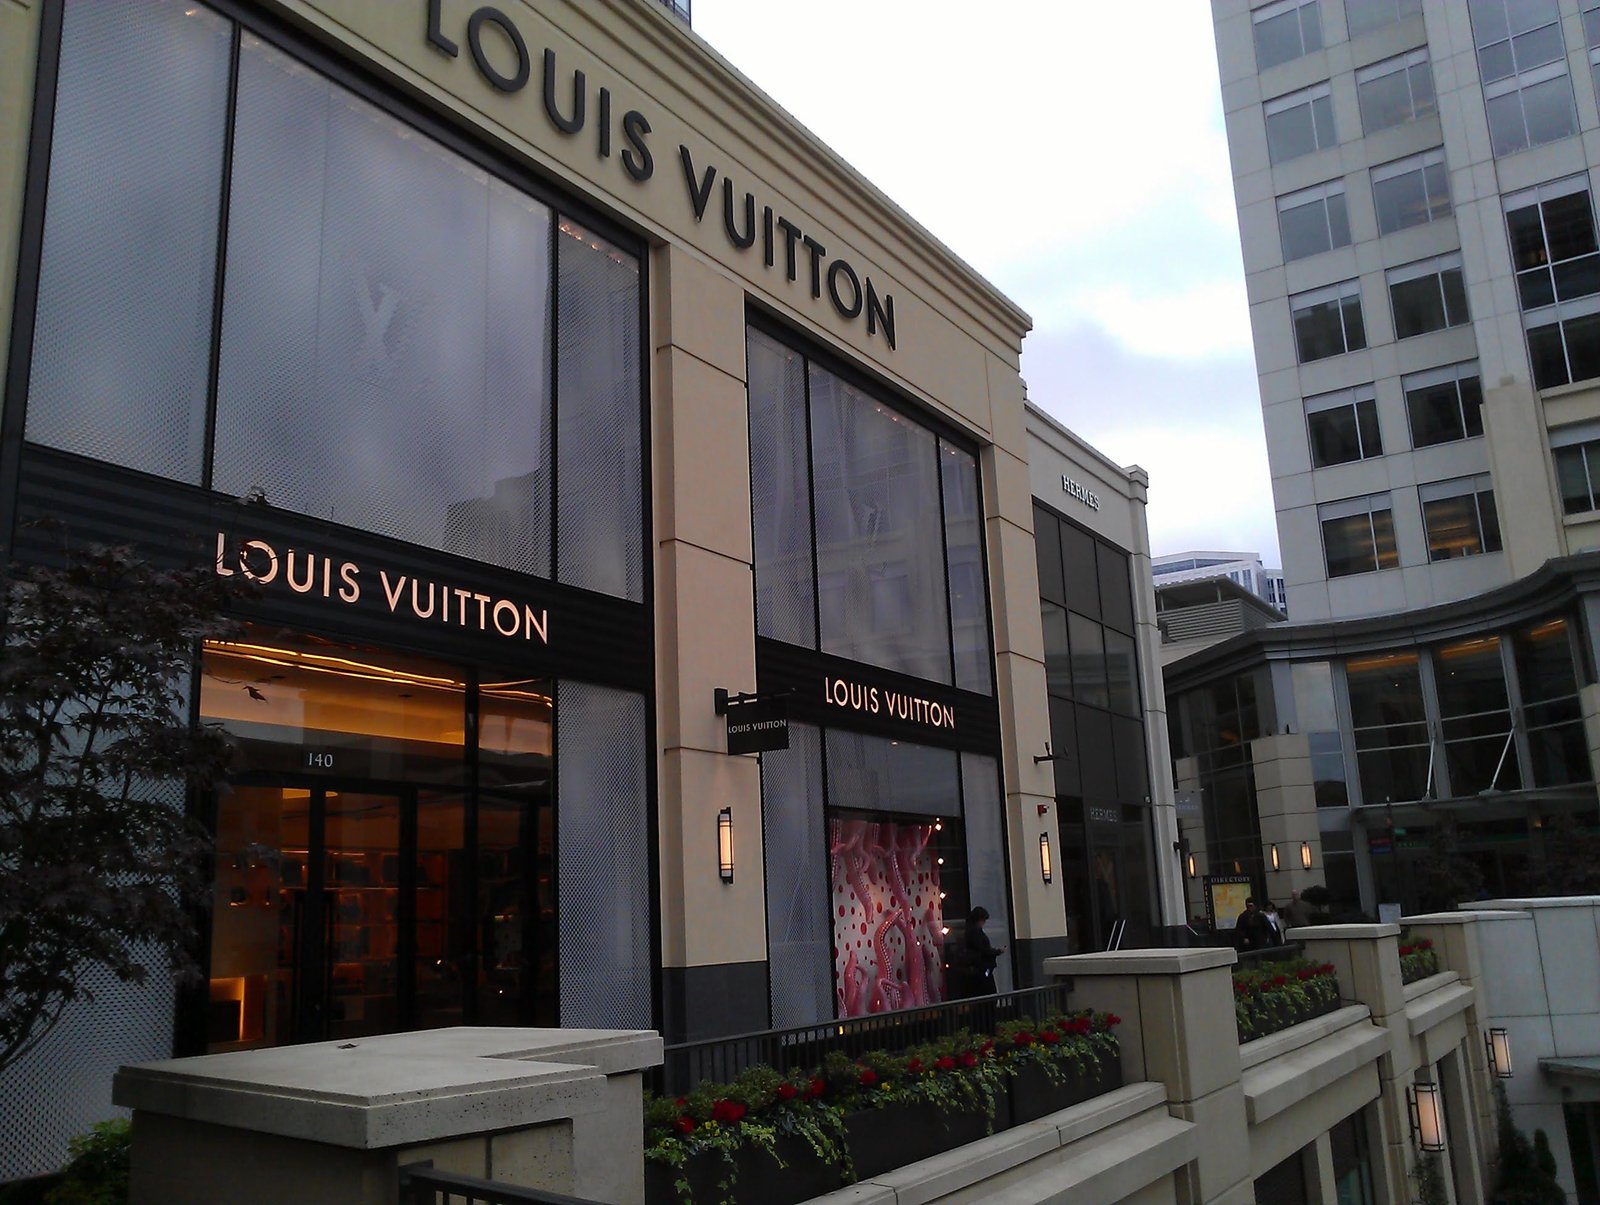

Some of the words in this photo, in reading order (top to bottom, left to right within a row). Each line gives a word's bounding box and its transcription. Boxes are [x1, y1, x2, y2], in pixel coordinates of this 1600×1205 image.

[427, 0, 654, 181] LOUIS
[680, 144, 896, 350] VUITTON
[216, 532, 361, 603] LOUIS
[380, 570, 548, 644] VUITTON
[728, 724, 750, 734] LOUIS
[752, 719, 787, 732] VUITTON
[825, 677, 879, 713] LOUIS
[885, 690, 955, 729] VUITTON
[308, 752, 334, 768] 140
